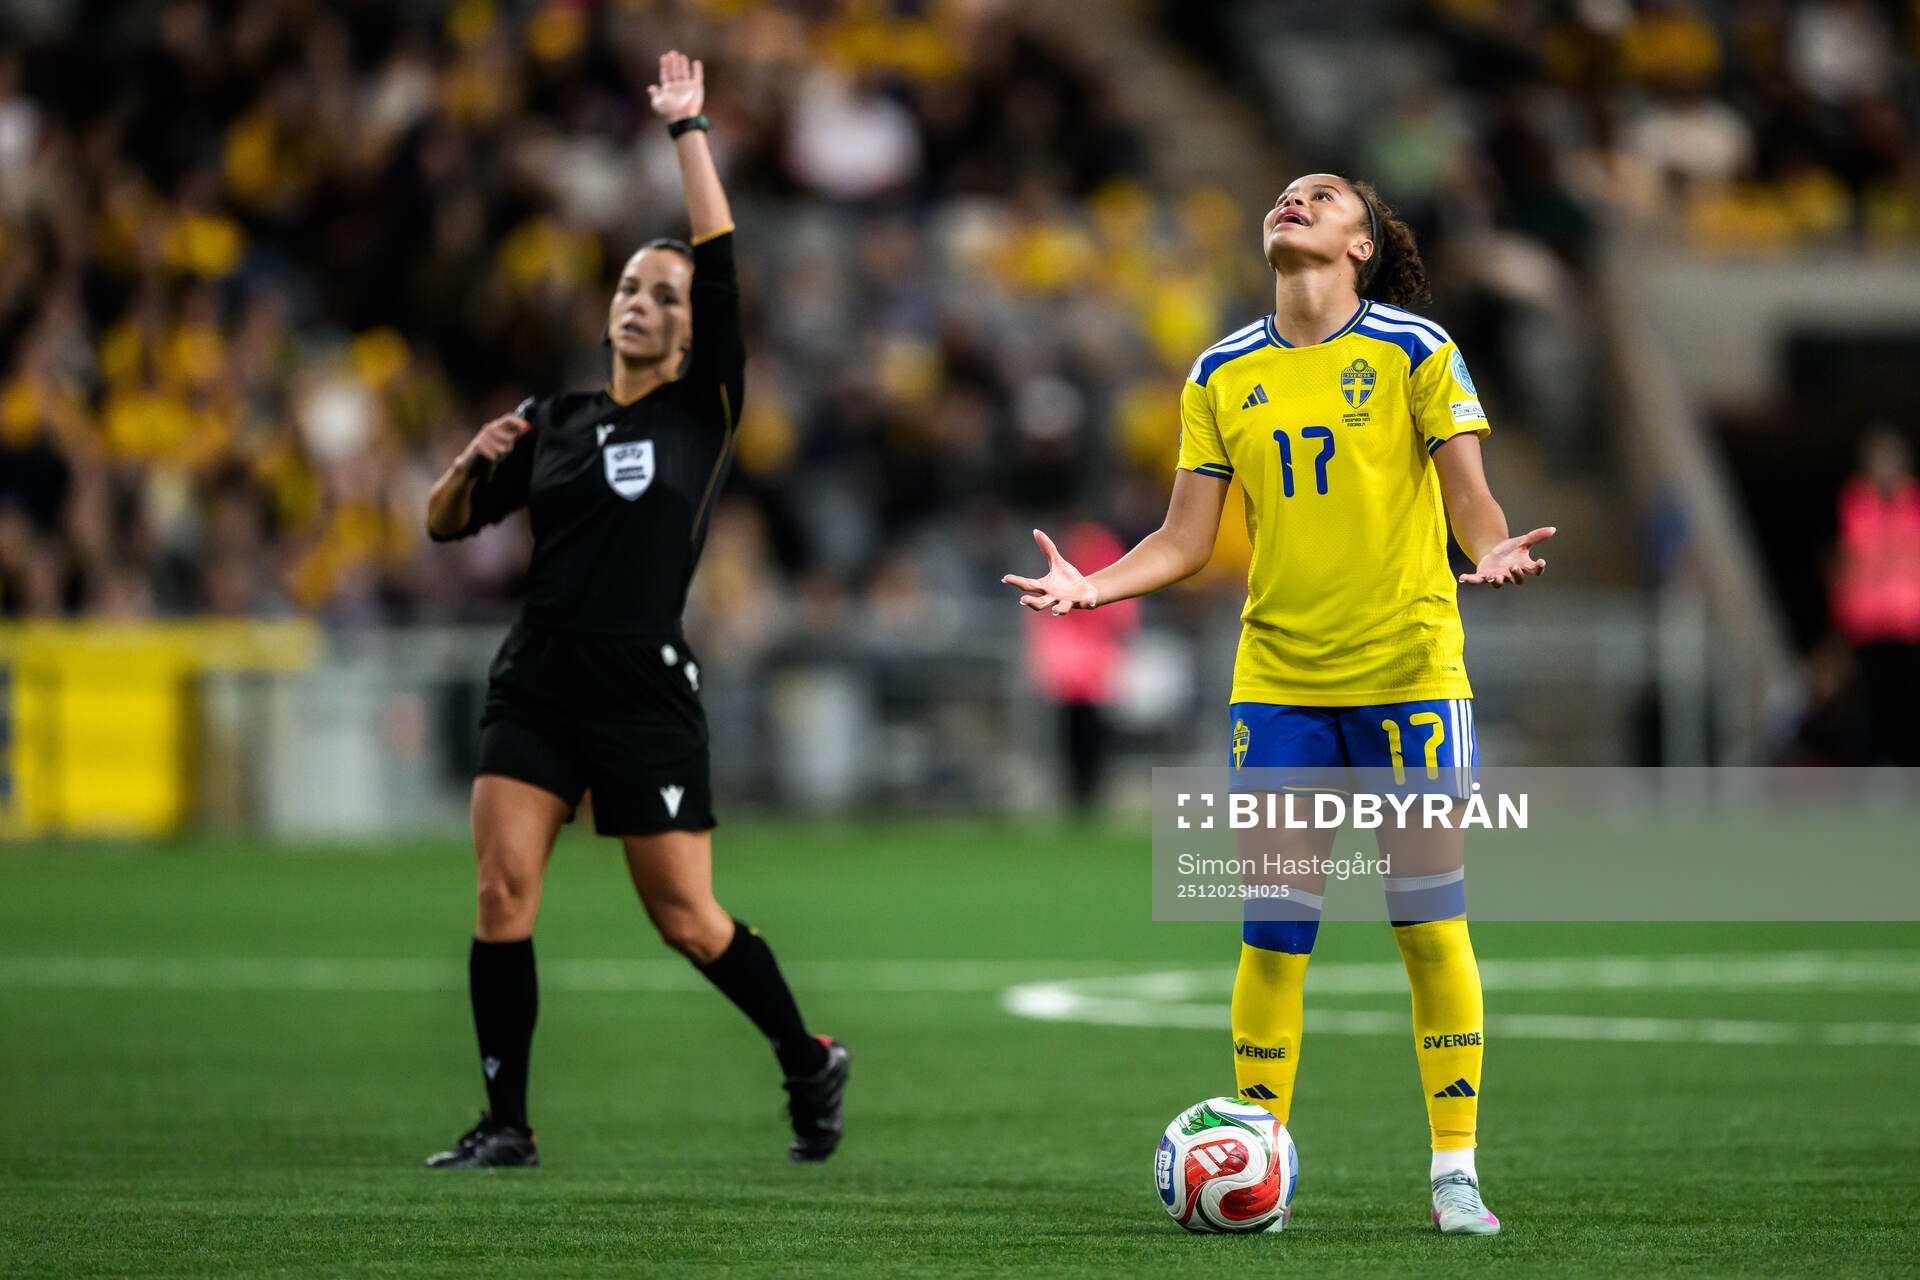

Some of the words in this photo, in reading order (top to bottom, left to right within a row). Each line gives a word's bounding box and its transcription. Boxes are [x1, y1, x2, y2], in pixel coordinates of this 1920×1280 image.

[1273, 426, 1335, 497] 17
[1382, 712, 1444, 785] 17
[1424, 1032, 1482, 1049] SVERIGE
